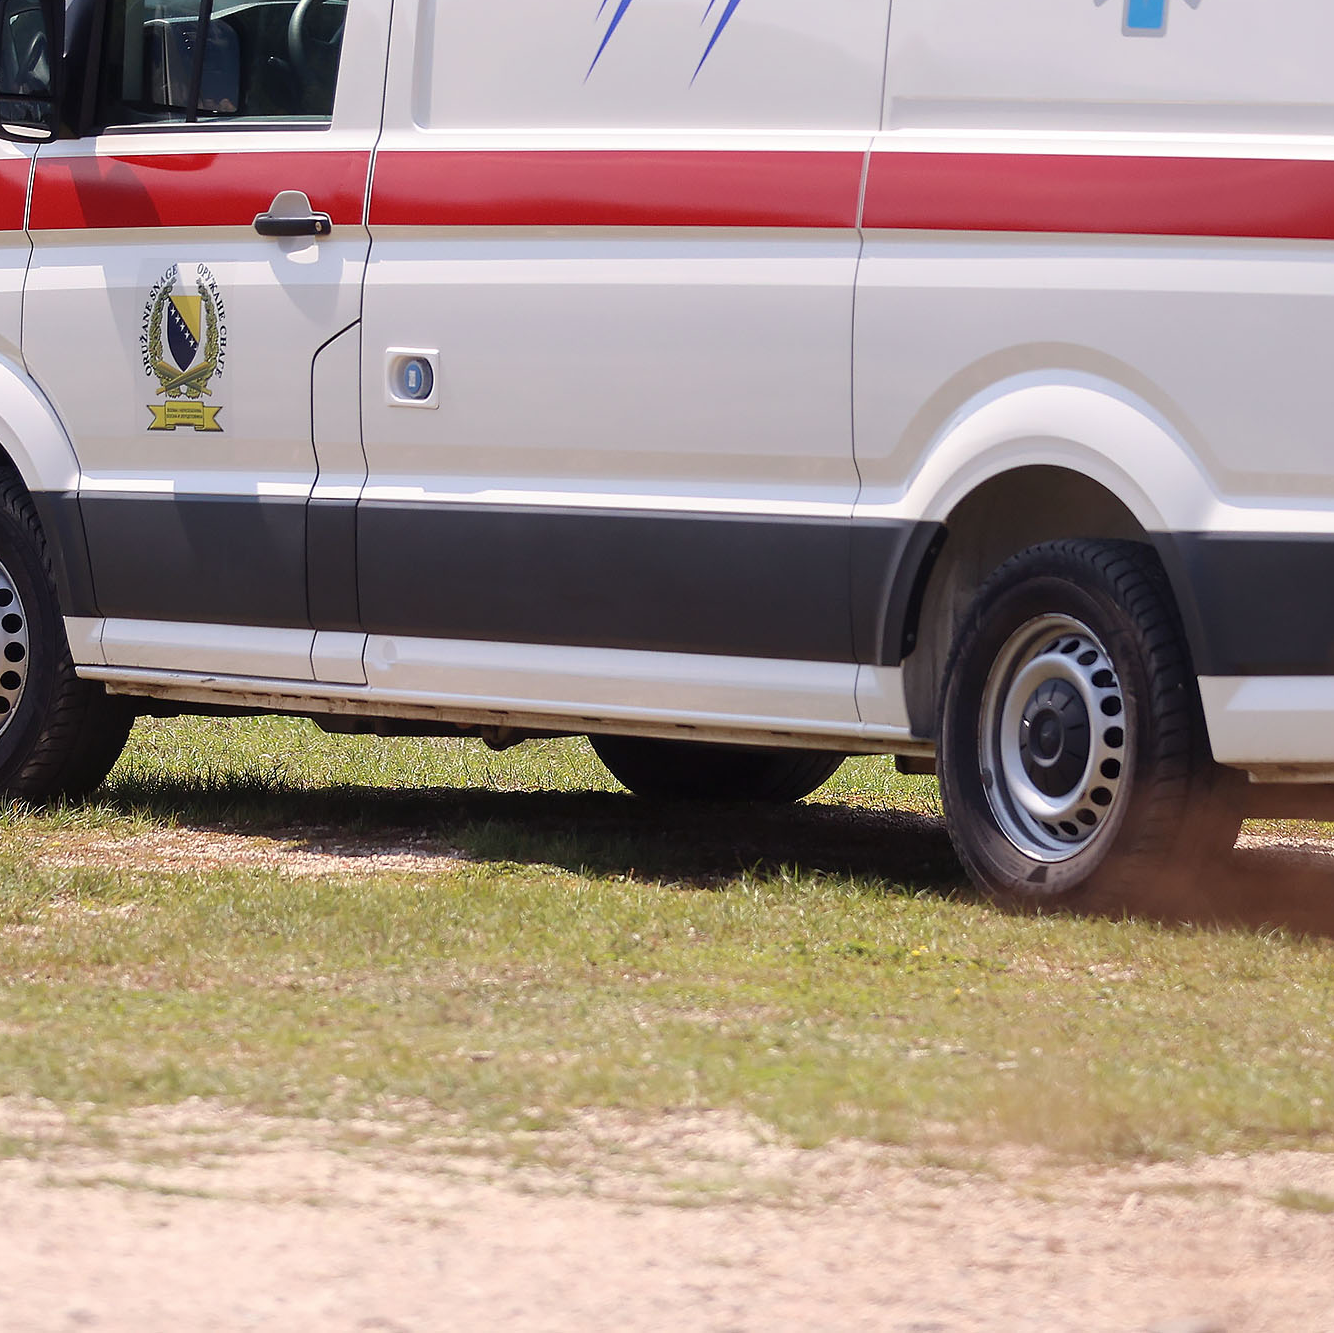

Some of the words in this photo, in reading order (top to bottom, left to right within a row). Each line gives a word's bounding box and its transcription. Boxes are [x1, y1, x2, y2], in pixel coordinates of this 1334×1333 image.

[139, 301, 153, 377] ORUŽANE
[149, 263, 178, 301] SNAGE
[196, 263, 226, 322] ОРУЖАНЕ
